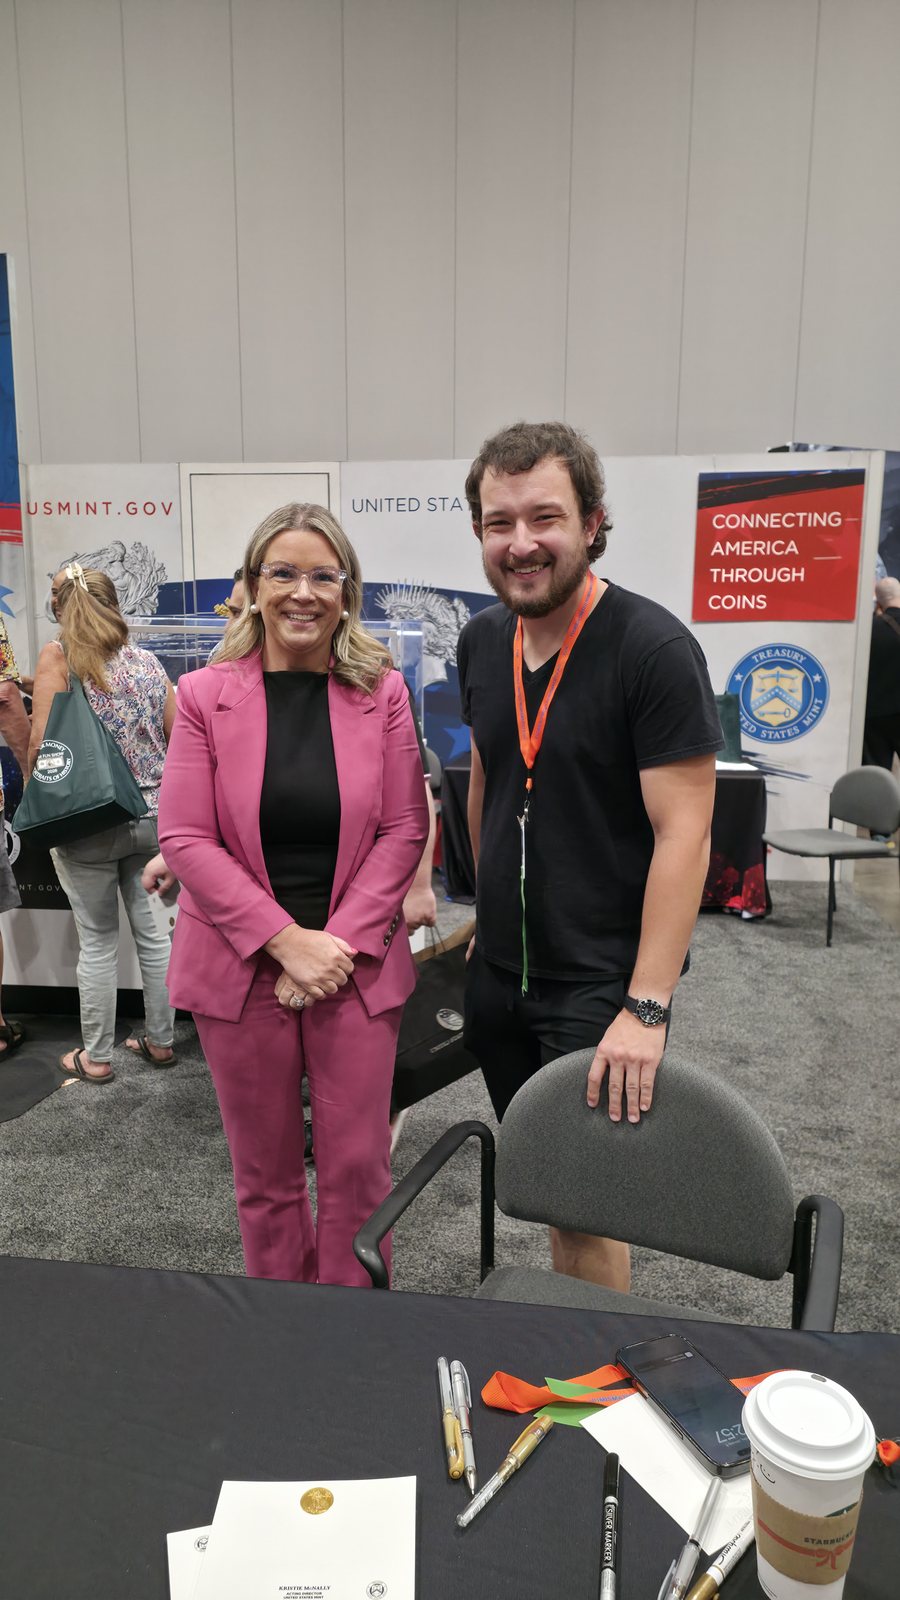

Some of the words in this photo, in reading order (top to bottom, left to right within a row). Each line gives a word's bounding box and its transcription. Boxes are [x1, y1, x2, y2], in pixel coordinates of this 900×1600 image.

[27, 502, 173, 515] USMINT.GOV
[352, 498, 421, 513] UNITED
[427, 497, 466, 512] STA
[712, 512, 842, 529] CONNECTING
[710, 540, 799, 556] AMERICA
[710, 567, 805, 583] THROUGH
[708, 595, 767, 610] COINS
[752, 649, 807, 664] TREASURY
[760, 725, 800, 740] STATES
[802, 698, 824, 727] MINT
[45, 742, 66, 752] MONEY
[605, 1507, 613, 1529] SILVER
[603, 1531, 613, 1561] MARKER
